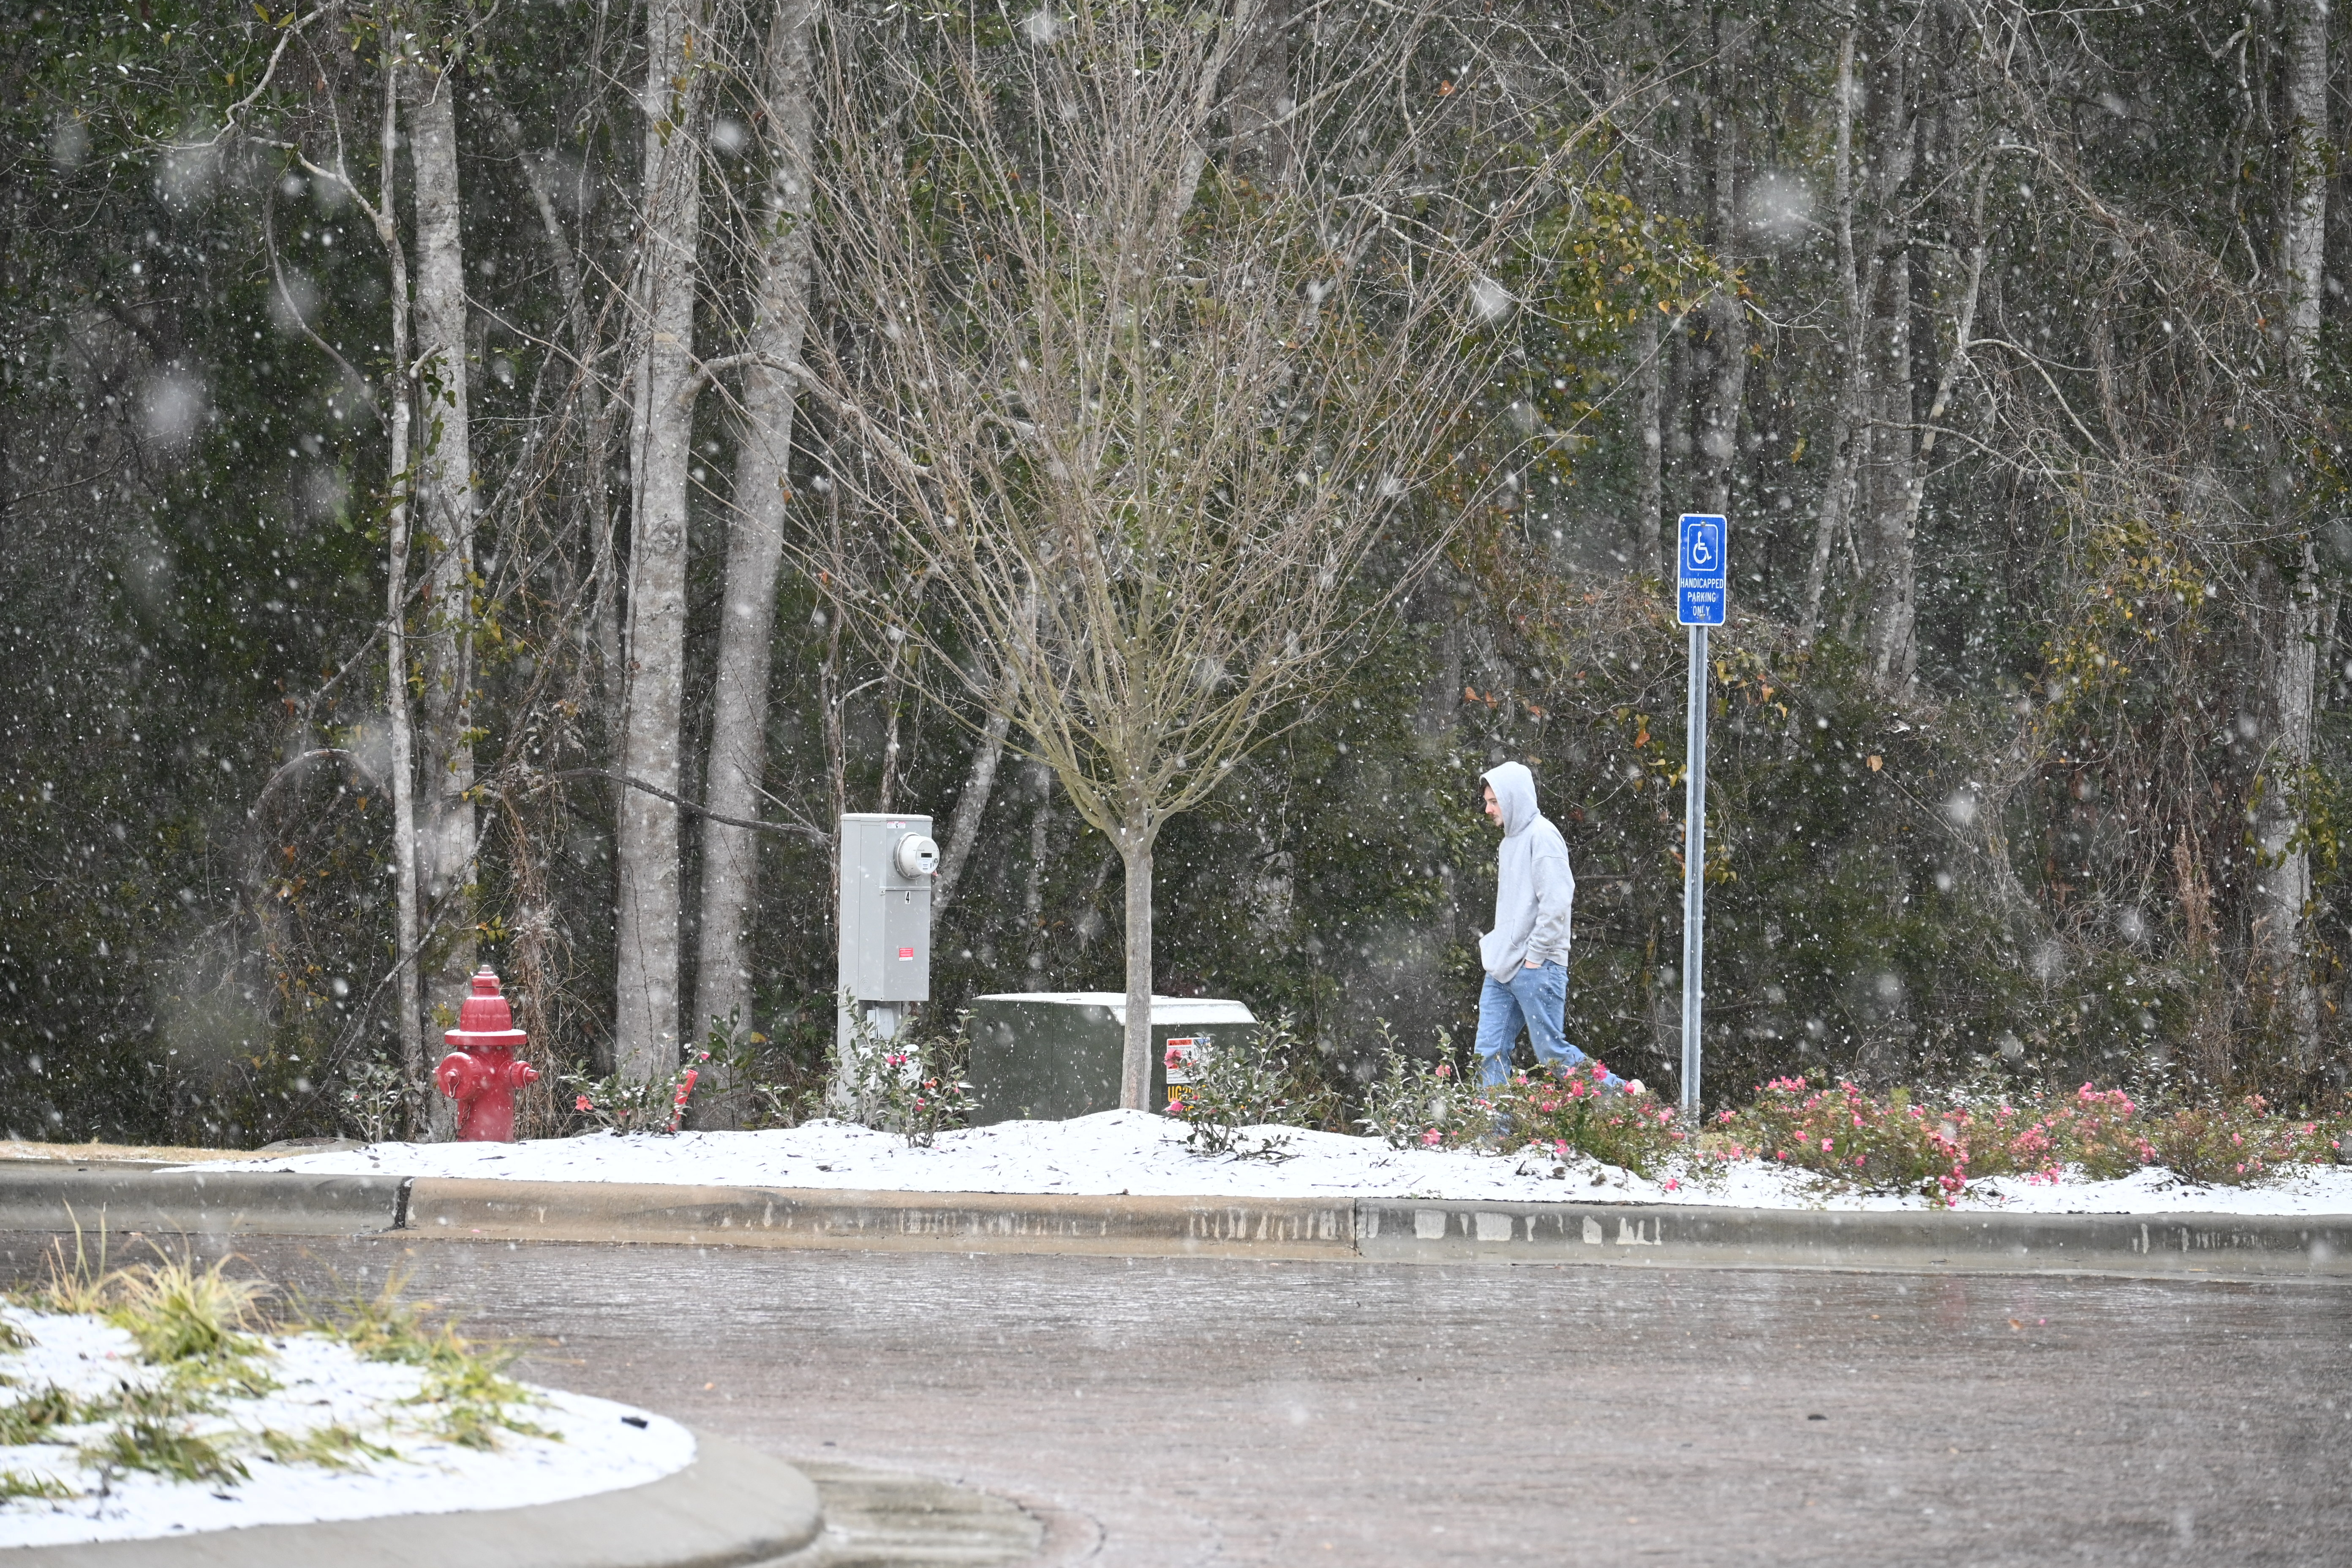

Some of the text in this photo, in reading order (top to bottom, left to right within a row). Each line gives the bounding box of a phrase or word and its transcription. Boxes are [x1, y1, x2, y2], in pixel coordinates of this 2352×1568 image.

[1680, 577, 1723, 588] HANDICAPPED
[1688, 591, 1716, 602] PARKING
[1693, 605, 1710, 616] ONLY
[906, 891, 909, 904] 4
